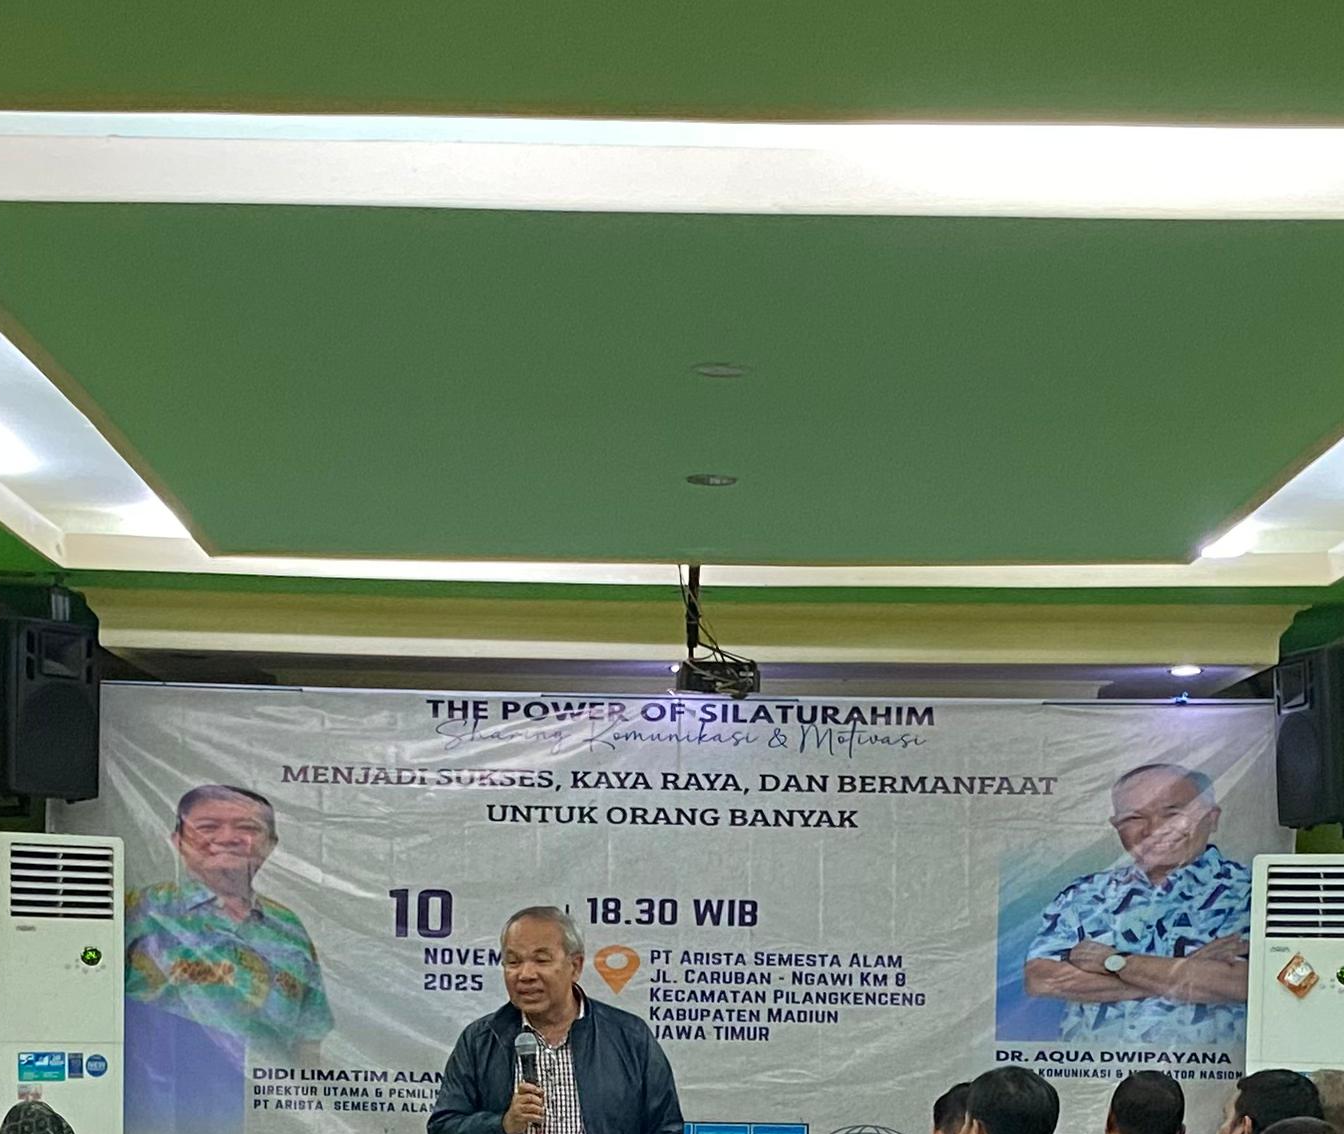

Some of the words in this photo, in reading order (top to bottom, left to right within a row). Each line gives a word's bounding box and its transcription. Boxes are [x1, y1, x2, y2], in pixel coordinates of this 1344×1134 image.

[426, 700, 489, 720] THE
[502, 701, 629, 722] POWER
[641, 702, 685, 724] OF
[699, 704, 935, 726] SILATURAHIM
[435, 717, 570, 755] Sharing
[582, 716, 760, 752] Komunikasi
[768, 728, 787, 748] &
[799, 717, 928, 758] Motivasi
[281, 765, 428, 785] MENJADI
[436, 768, 562, 792] SUKSES,
[570, 771, 653, 790] KAYA
[661, 773, 749, 795] RAYA,
[759, 774, 829, 793] DAN
[837, 775, 1058, 795] BERMANFAAT
[487, 805, 598, 824] UNTUK
[606, 807, 720, 826] ORANG
[729, 809, 859, 828] BANYAK
[389, 889, 453, 938] 10
[587, 897, 678, 925] 18.30
[693, 899, 758, 927] WIB
[424, 948, 502, 966] NOVEM
[650, 950, 672, 965] PT
[424, 974, 483, 991] 2025
[650, 969, 677, 984] JL.
[713, 1026, 770, 1041] TIMUR
[995, 1050, 1029, 1063] DR.
[1034, 1050, 1095, 1063] AQUA
[1100, 1051, 1231, 1064] DWIPAYANA
[253, 1068, 295, 1080] DIDI
[301, 1069, 388, 1082] LIMATIM
[1038, 1068, 1111, 1079] KOMUNIKASI
[1115, 1069, 1123, 1079] &
[1199, 1070, 1243, 1080] NASION
[253, 1085, 317, 1096] DIREKTUR
[323, 1087, 369, 1098] UTAMA
[375, 1088, 383, 1098] &
[253, 1099, 269, 1110] PT
[275, 1100, 324, 1111] ARISTA
[334, 1101, 395, 1112] SEMESTA
